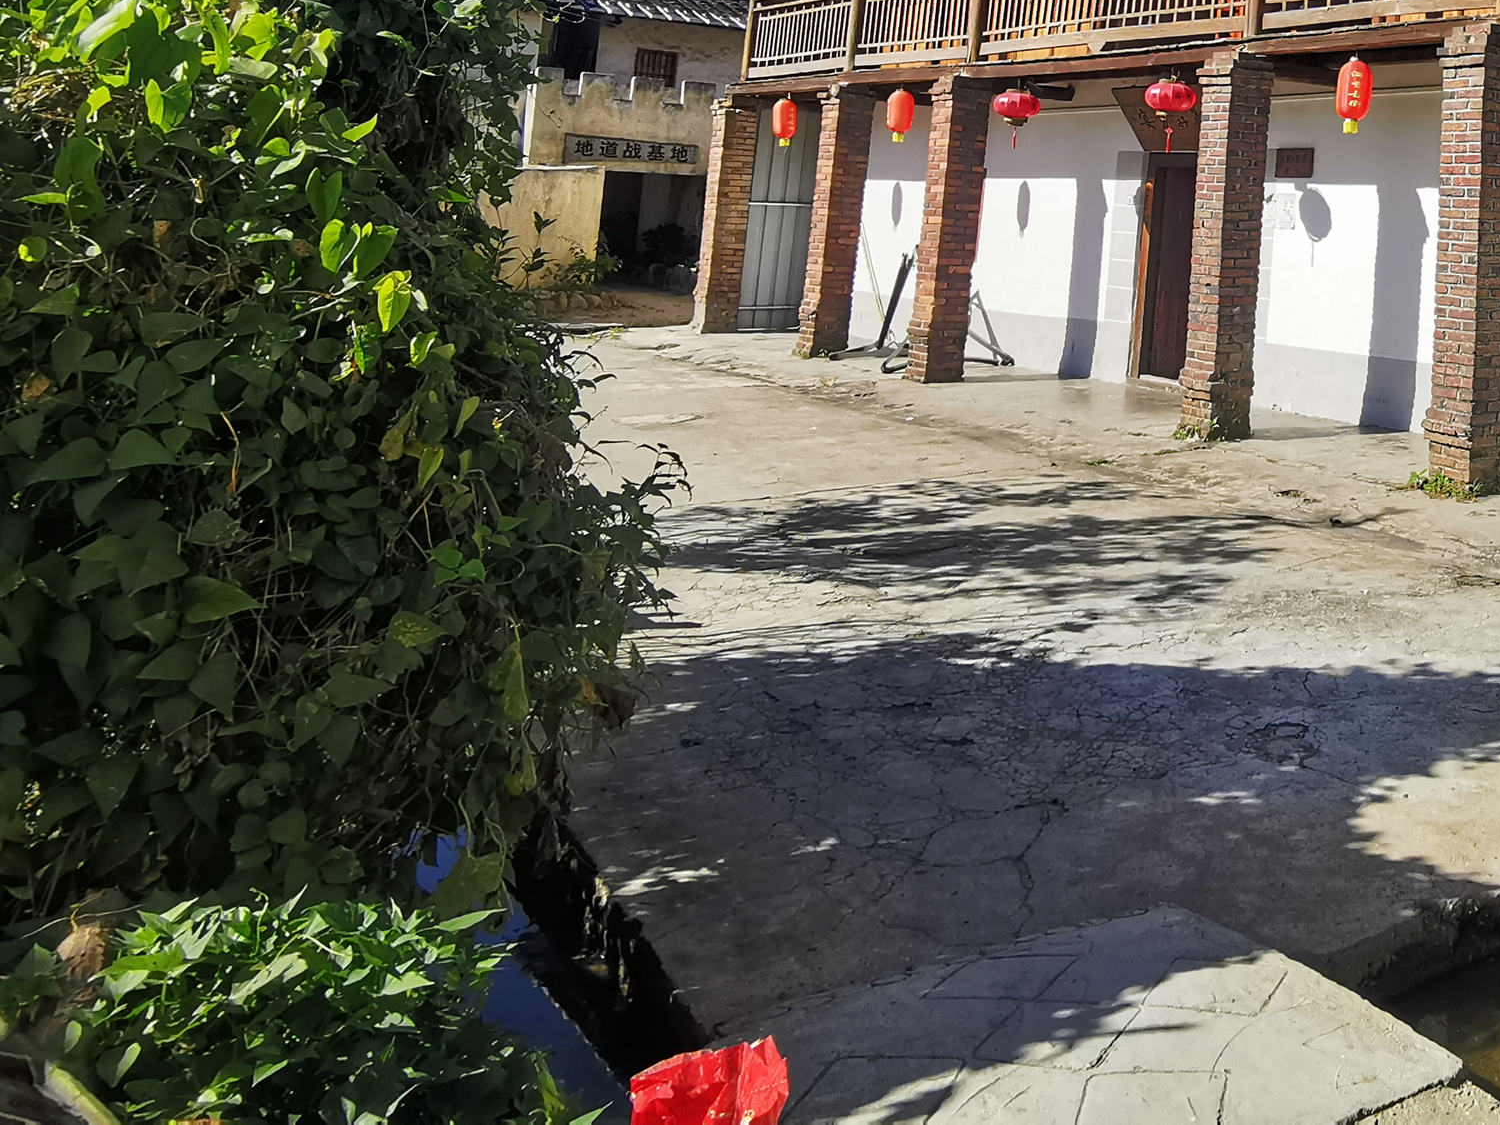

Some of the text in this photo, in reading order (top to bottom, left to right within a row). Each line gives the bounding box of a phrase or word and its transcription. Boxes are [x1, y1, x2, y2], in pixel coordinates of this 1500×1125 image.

[574, 139, 689, 163] 地道战基地
